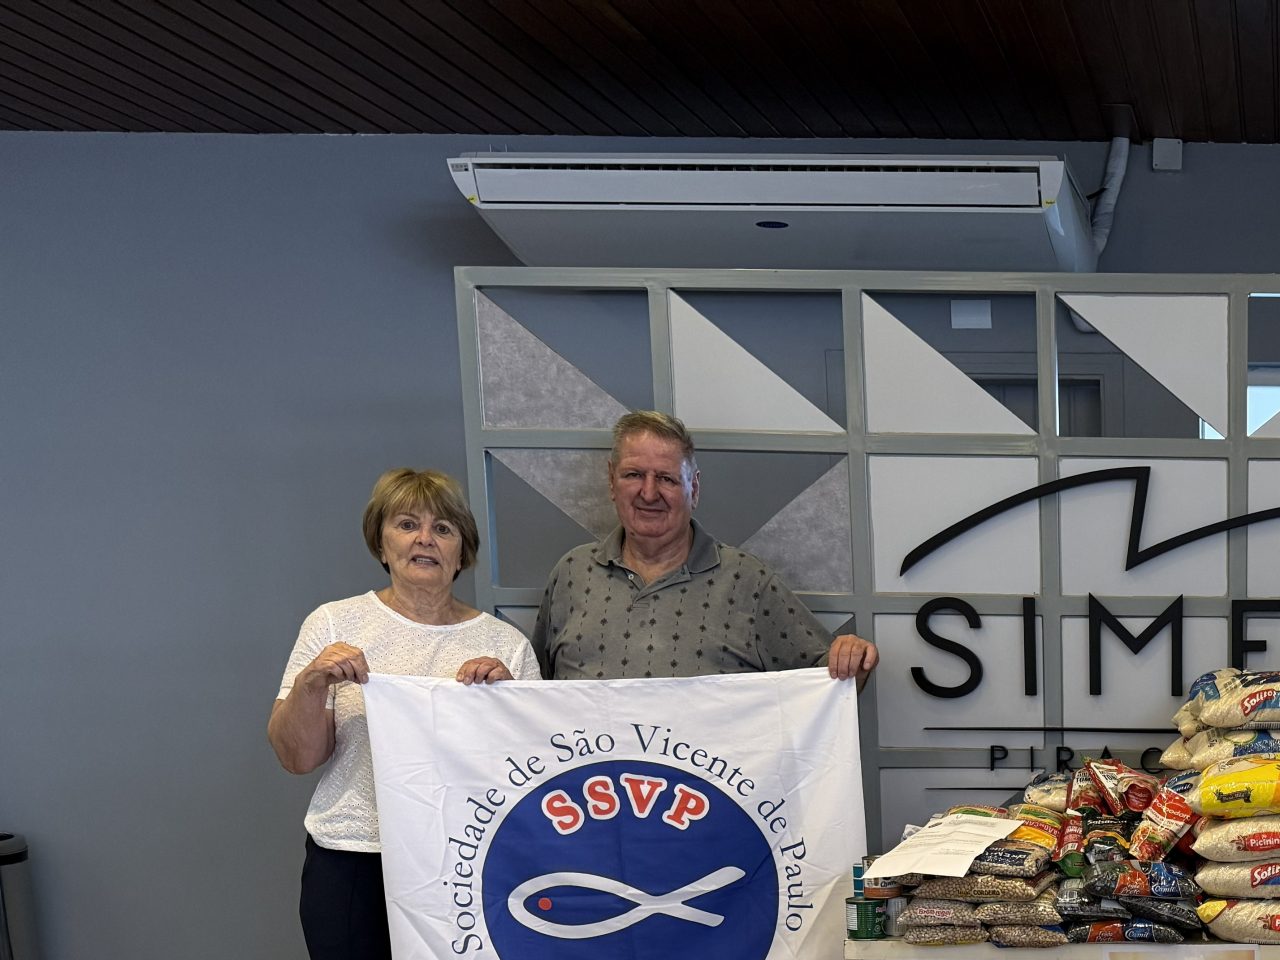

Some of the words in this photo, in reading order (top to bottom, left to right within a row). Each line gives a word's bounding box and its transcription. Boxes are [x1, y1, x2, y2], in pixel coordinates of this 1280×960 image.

[542, 773, 710, 836] SSVP
[442, 786, 506, 955] Sociedade
[505, 751, 546, 790] de
[550, 729, 616, 764] São
[631, 723, 756, 798] Vicente
[758, 798, 787, 835] de
[780, 837, 815, 933] Paulo
[1250, 837, 1280, 847] Picinin
